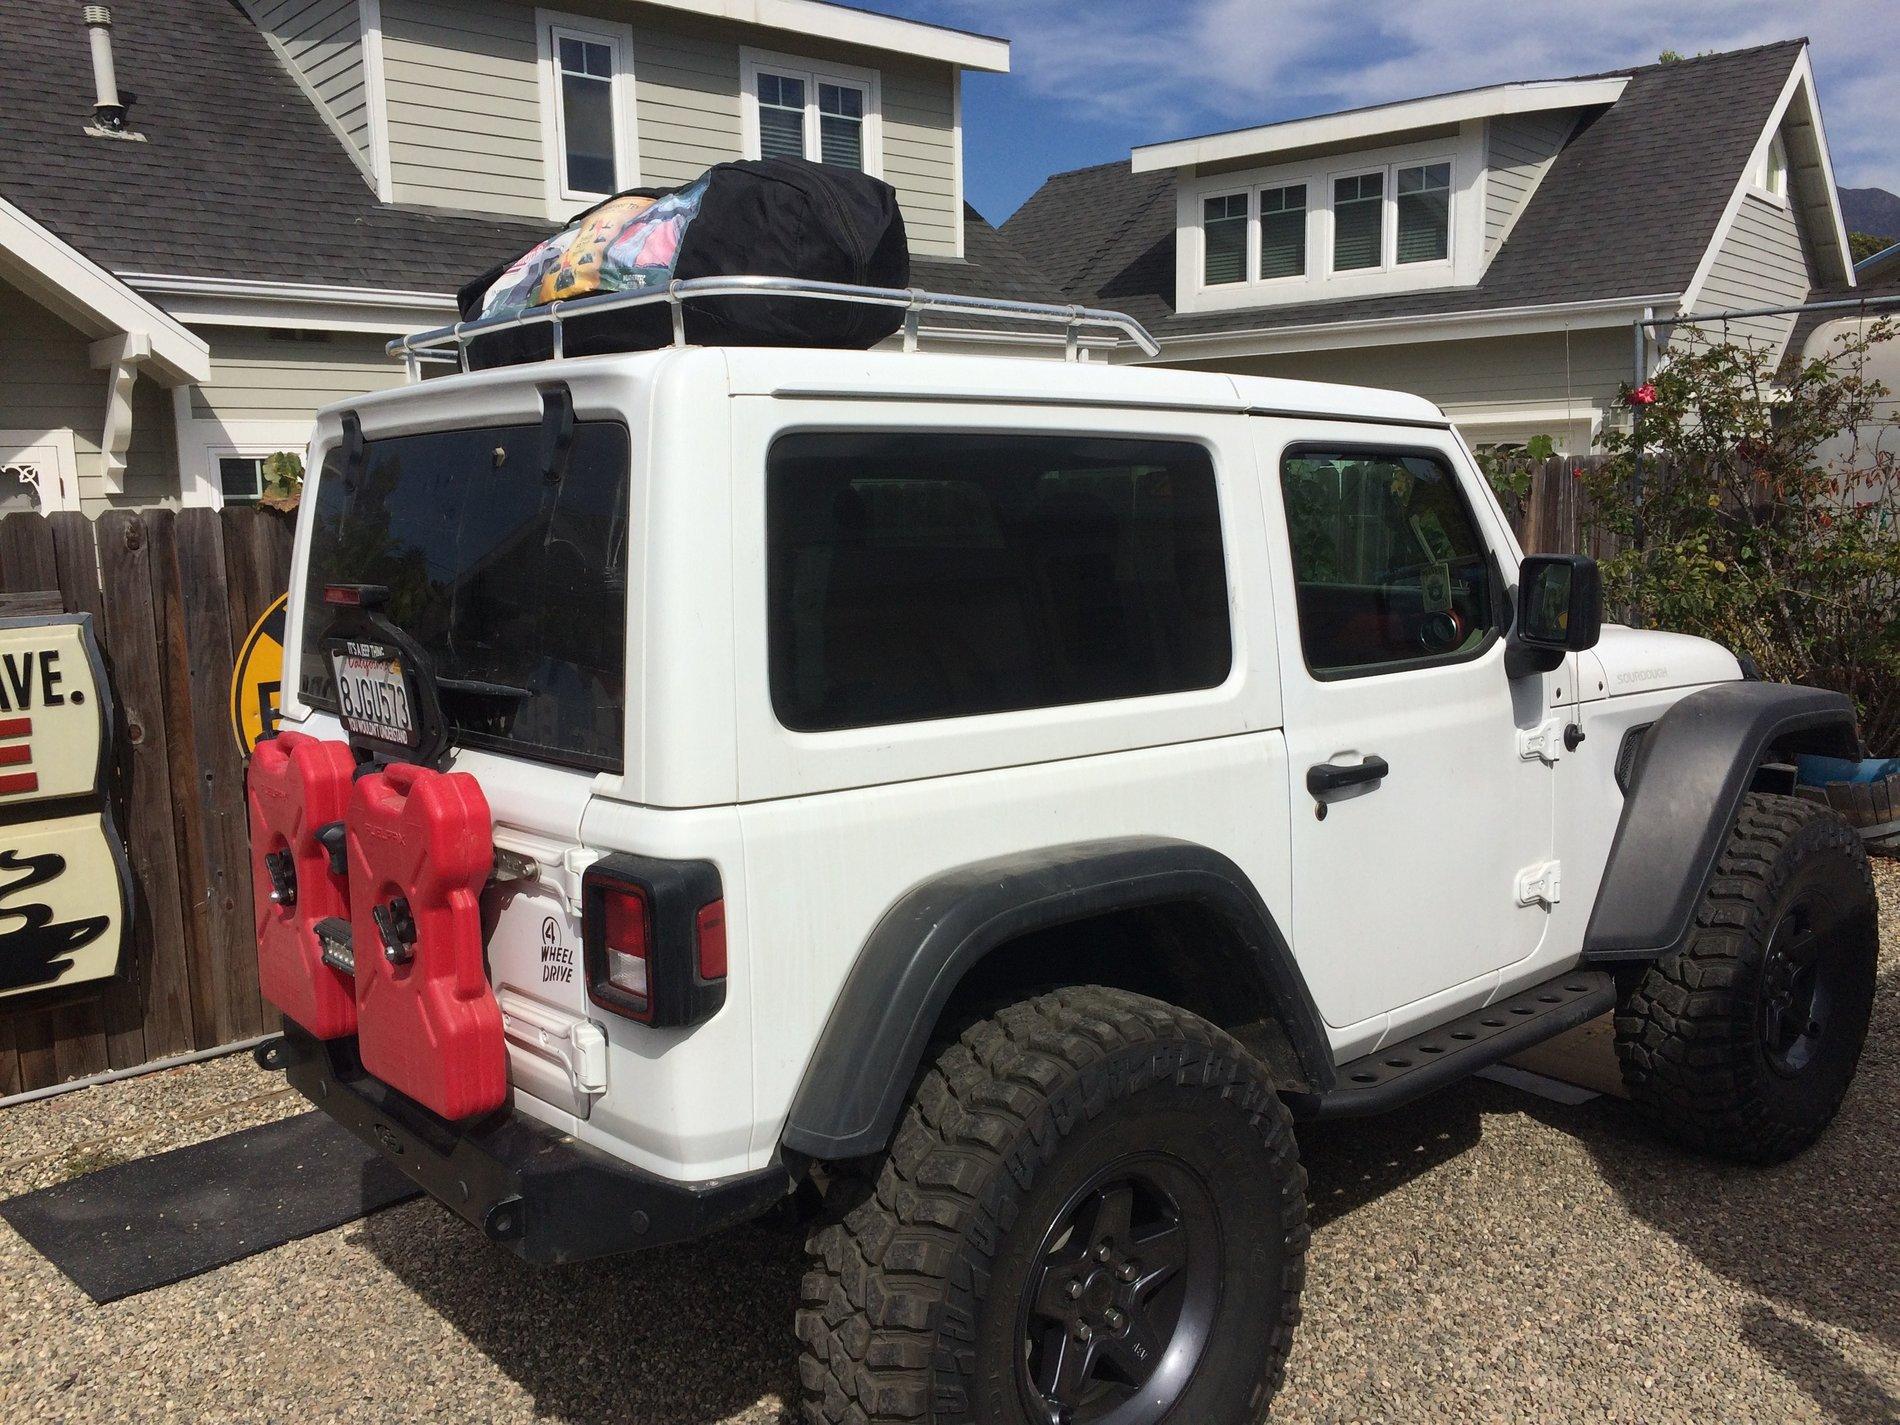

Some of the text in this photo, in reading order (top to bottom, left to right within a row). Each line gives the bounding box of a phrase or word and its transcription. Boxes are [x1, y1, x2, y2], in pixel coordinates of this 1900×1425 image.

[0, 650, 85, 711] VE.
[340, 676, 410, 730] 8JGU573
[545, 921, 555, 944] 4
[541, 945, 573, 965] WHEEL
[542, 964, 573, 983] DRIVE
